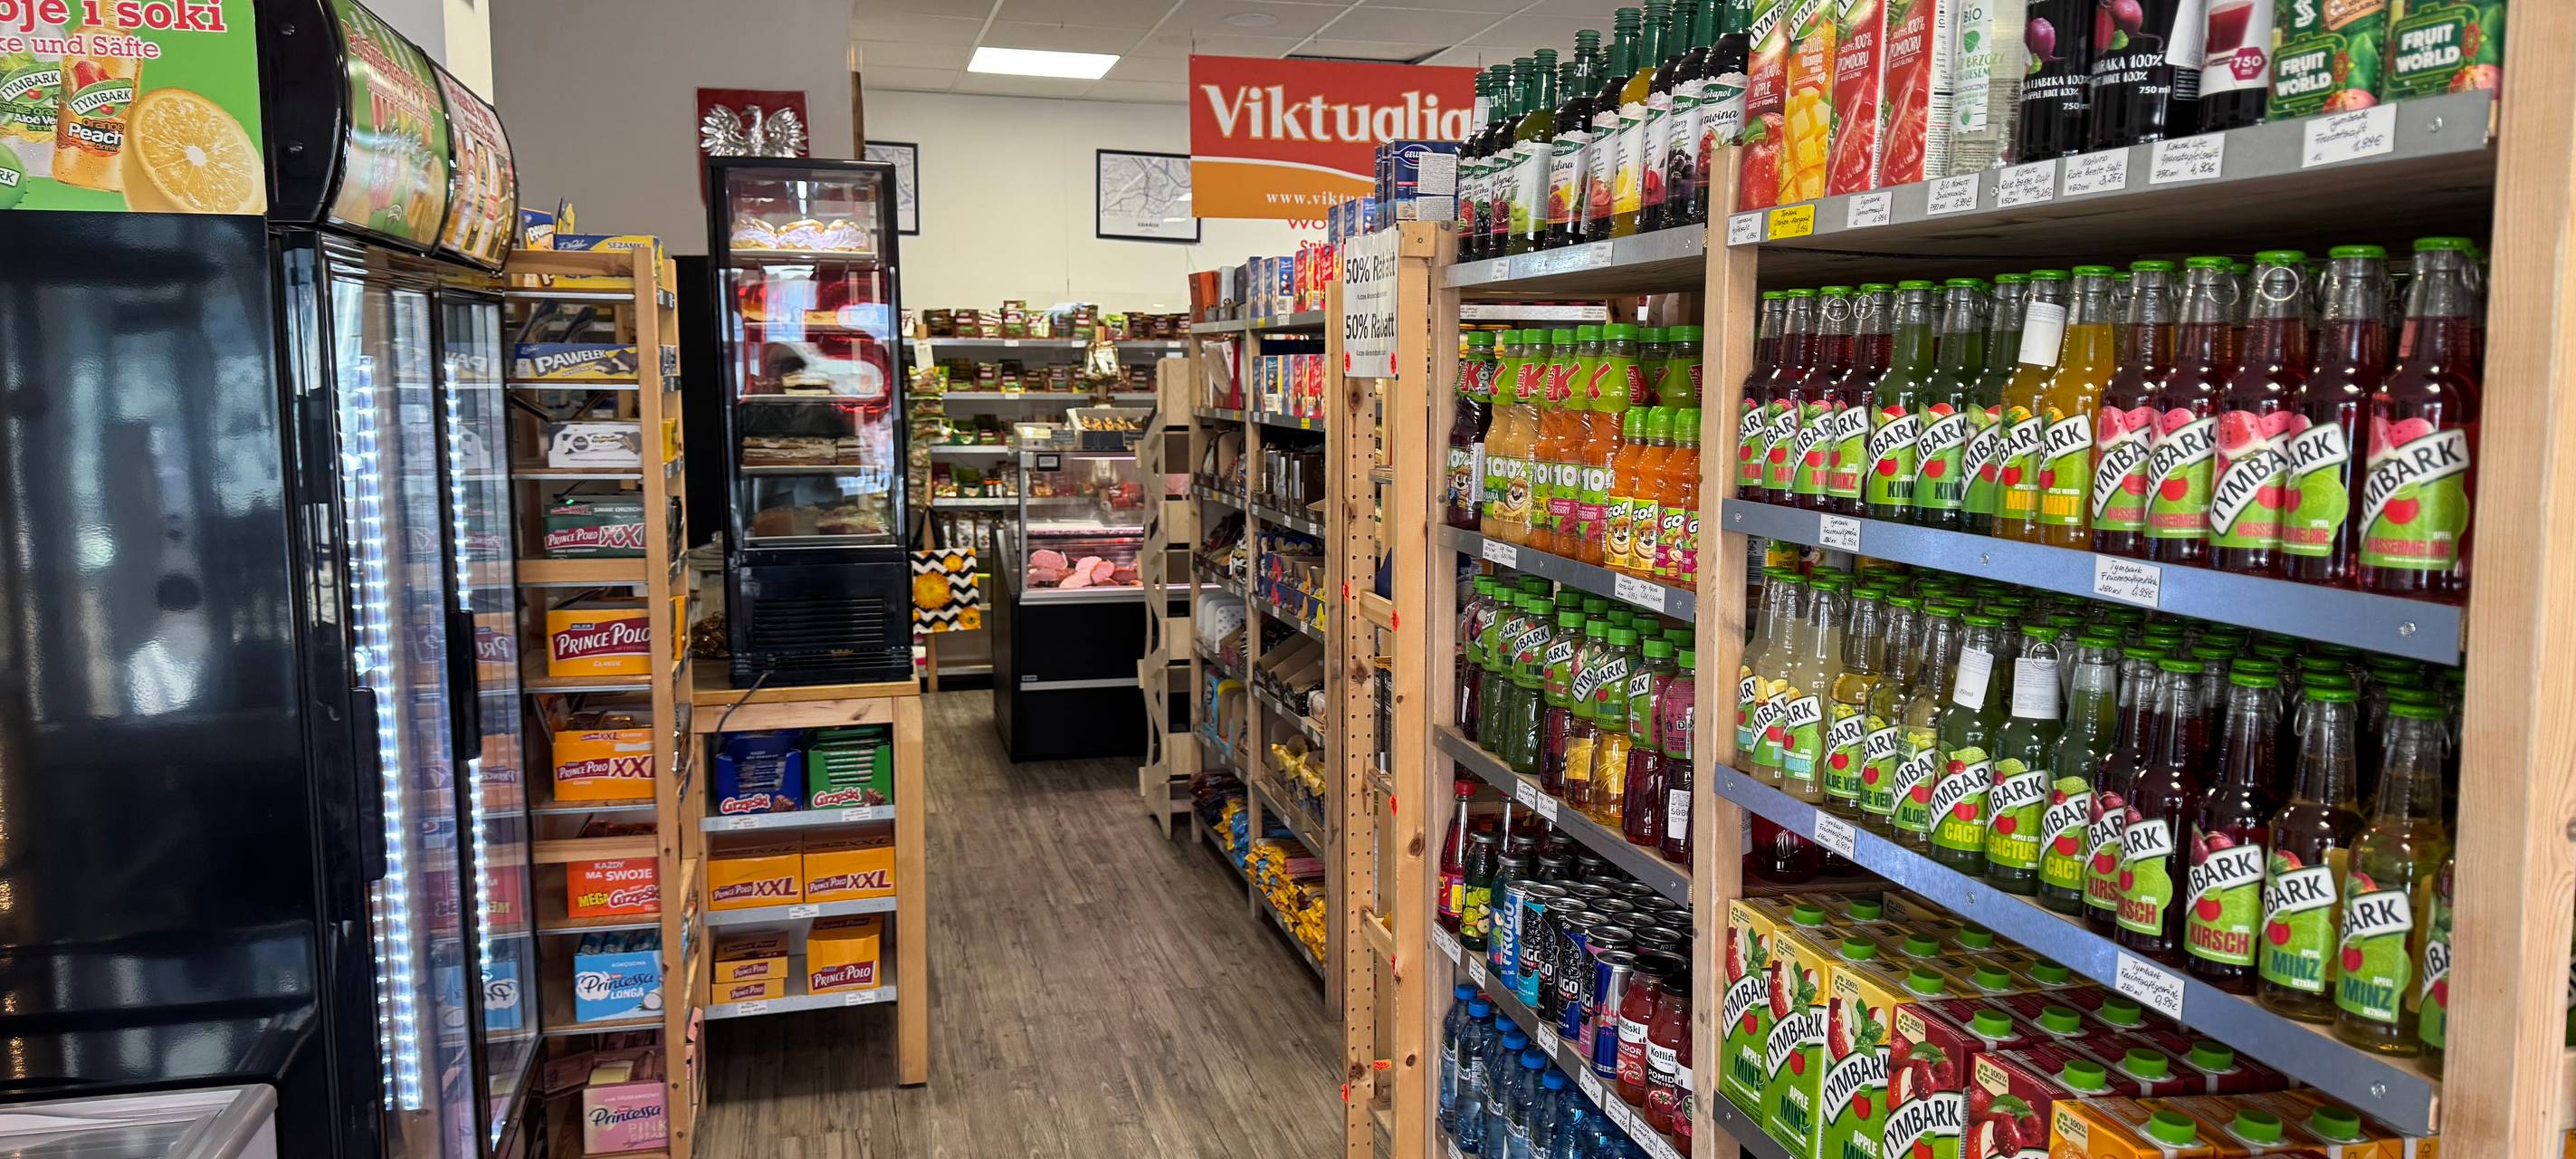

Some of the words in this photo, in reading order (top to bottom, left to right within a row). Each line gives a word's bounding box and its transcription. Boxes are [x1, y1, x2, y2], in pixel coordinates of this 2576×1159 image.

[118, 0, 225, 32] soki
[32, 37, 86, 55] und
[93, 36, 160, 58] Säfte
[2401, 24, 2455, 51] FRUIT
[2130, 54, 2164, 69] 100%
[2234, 56, 2262, 68] 750
[2280, 52, 2326, 77] FRUIT
[2397, 46, 2461, 72] WORLD
[4, 72, 58, 98] TYMBARK
[2123, 71, 2148, 82] 100%
[2276, 72, 2333, 97] WORLD
[1753, 81, 1772, 98] APPLE
[2138, 85, 2157, 94] 750
[2158, 85, 2171, 94] ml
[75, 91, 130, 112] TYMBARK
[2063, 102, 2080, 110] 750
[14, 114, 42, 124] Aloe
[82, 118, 124, 131] orange
[68, 122, 122, 145] Peach
[1346, 250, 1369, 264] 50%
[1373, 248, 1396, 263] Rabatt
[1346, 279, 1369, 292] 50%
[1371, 278, 1395, 292] Rabatt
[1632, 505, 1655, 521] GO!
[2041, 495, 2079, 516] MINT
[548, 531, 575, 545] PRINCE
[556, 632, 609, 656] PRINCE
[609, 622, 651, 646] POLO
[558, 764, 585, 779] PRINCE
[585, 758, 608, 774] POLO
[1902, 806, 1925, 823] ALOE
[1989, 835, 2038, 861] CACTUS
[586, 870, 603, 881] MA
[606, 867, 653, 882] SWOJE
[848, 870, 892, 889] XXL
[753, 877, 799, 896] XXL
[2190, 921, 2250, 956] KIRSCH
[2131, 960, 2162, 981] Tymbark
[2271, 950, 2320, 981] MINZ
[584, 972, 654, 993] Princessa
[814, 972, 846, 988] PRINCE
[846, 966, 872, 982] POLO
[1845, 978, 1859, 991] 100%
[610, 987, 644, 1001] LONGA
[2154, 994, 2179, 1011] 0,99€
[2343, 976, 2394, 1011] MINZ
[1910, 1018, 1925, 1033] 100%
[1767, 1012, 1825, 1069] TYMBARK
[1742, 1043, 1761, 1068] APPLE
[1734, 1053, 1761, 1090] MINT
[1990, 1068, 2008, 1083] 100%
[1789, 1085, 1809, 1111] APPLE
[588, 1103, 662, 1126] Princessa
[1780, 1094, 1808, 1134] MINT
[1884, 1099, 1961, 1159] TYMBARK
[1853, 1129, 1878, 1158] APPLE
